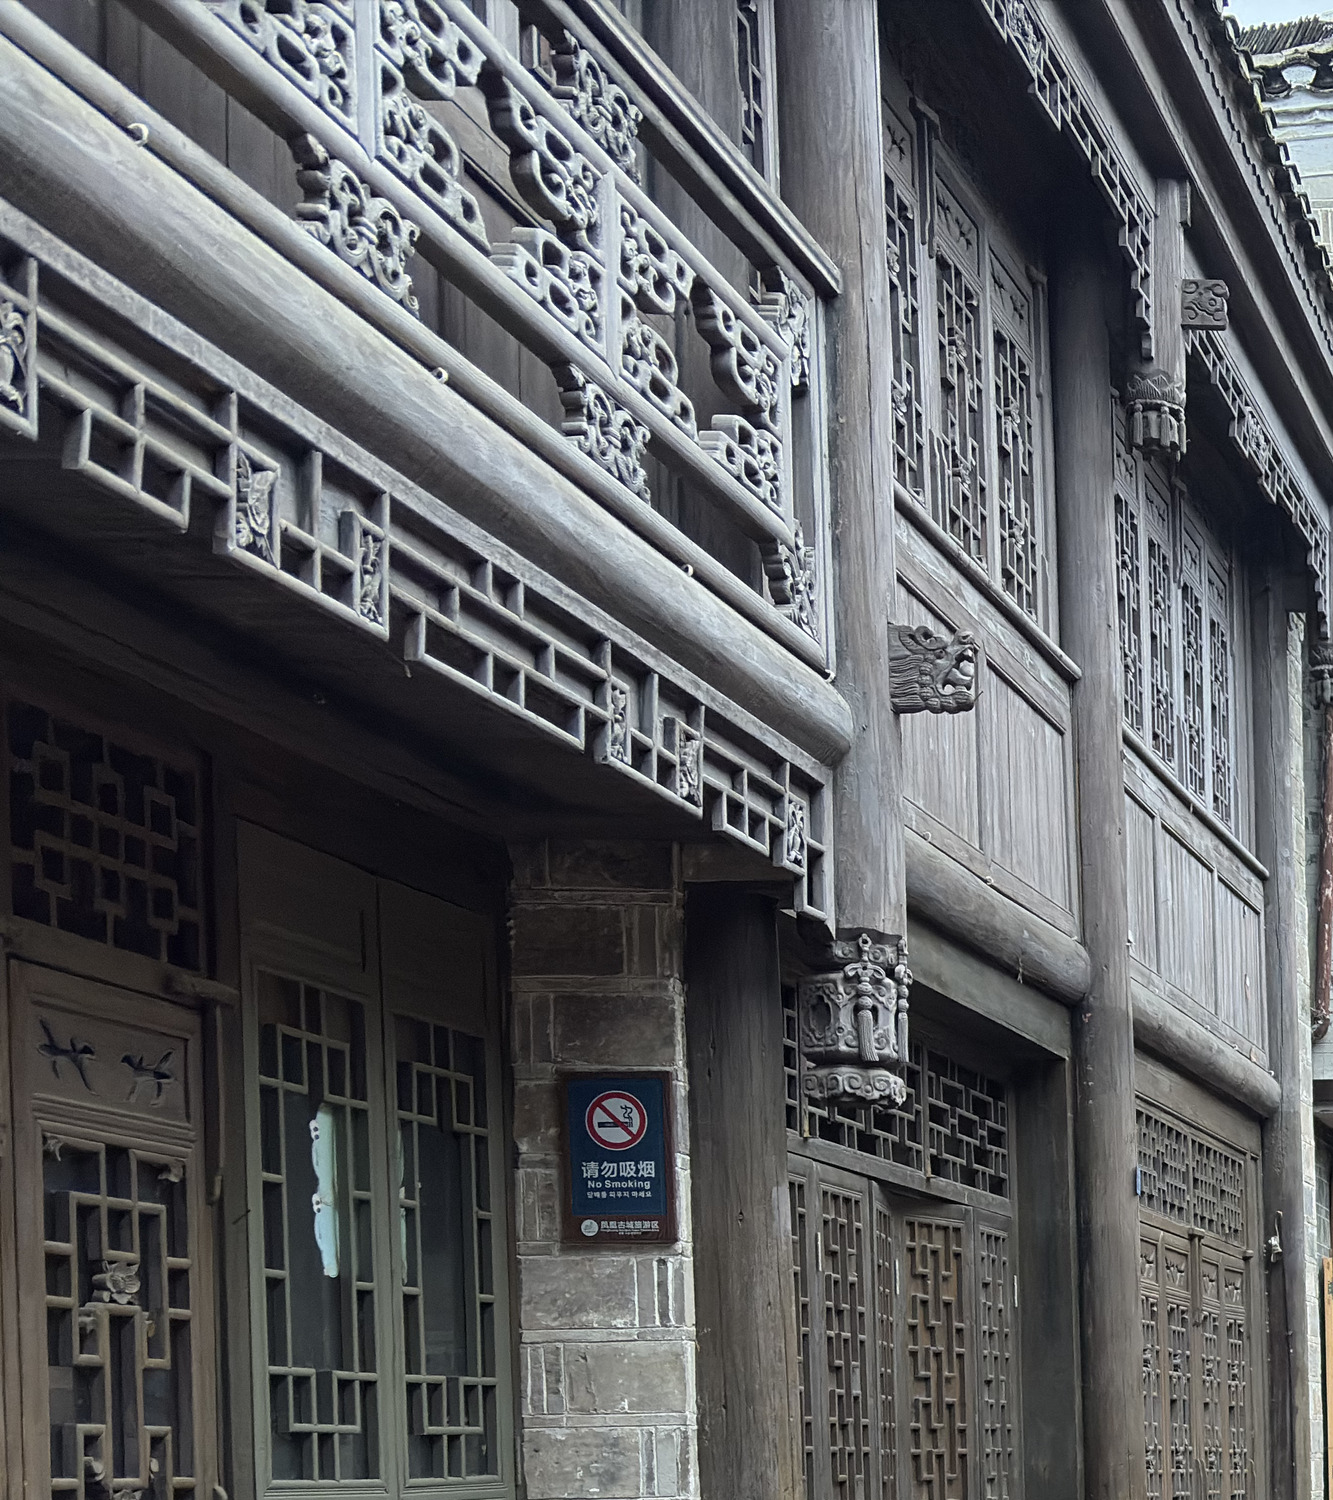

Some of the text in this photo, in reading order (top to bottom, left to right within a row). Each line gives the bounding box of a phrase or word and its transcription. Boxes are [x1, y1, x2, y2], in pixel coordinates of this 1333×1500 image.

[581, 1160, 656, 1179] 请勿吸烟
[587, 1180, 651, 1190] No Smoking
